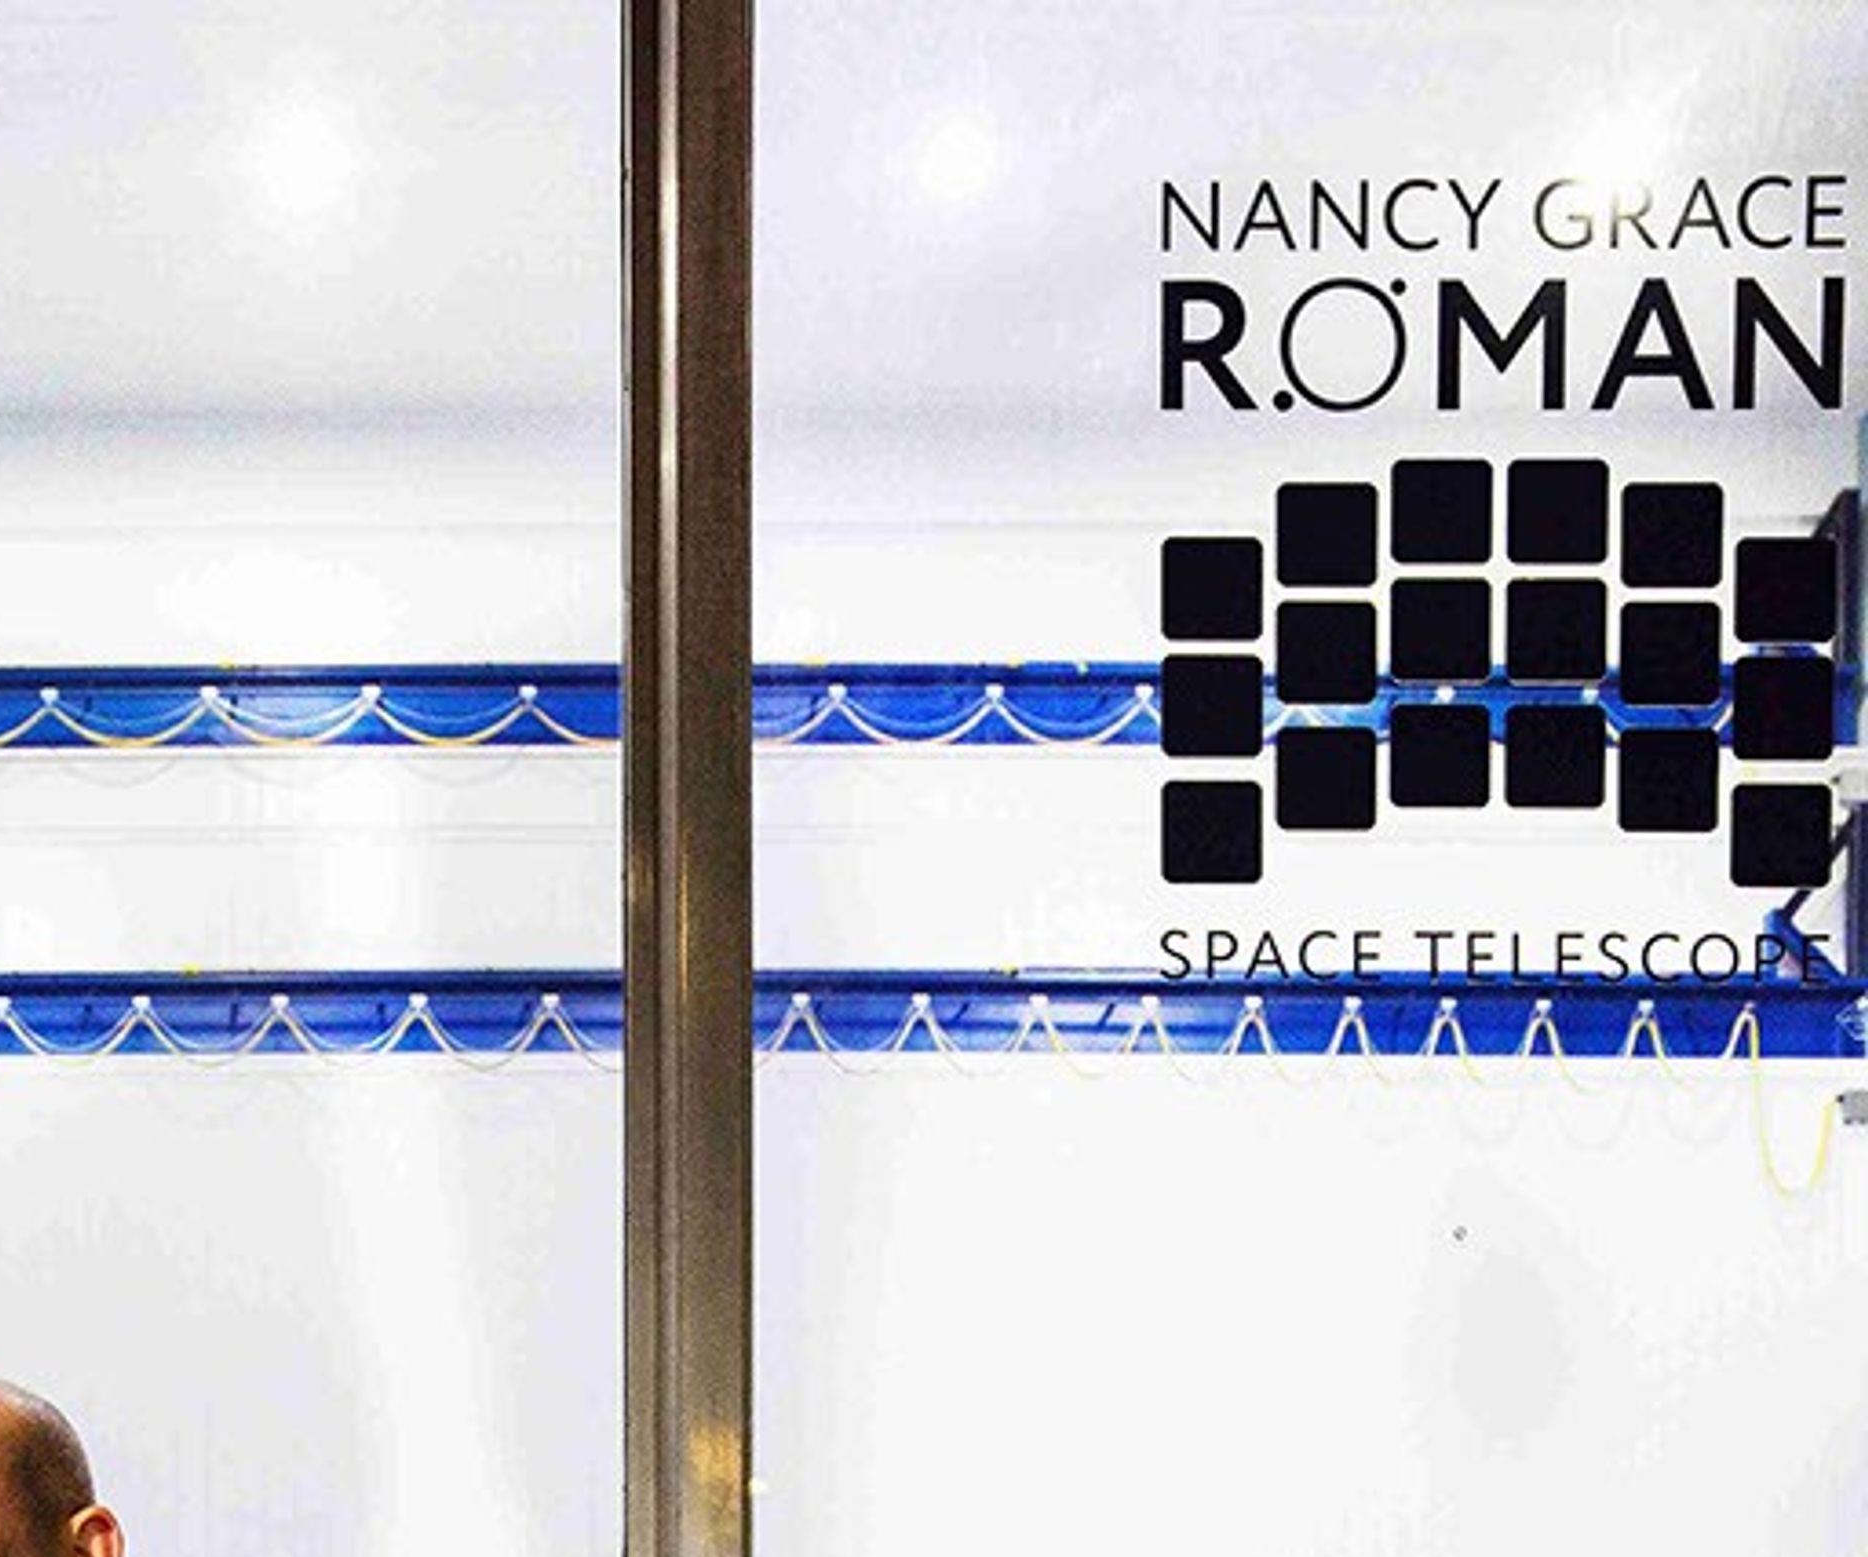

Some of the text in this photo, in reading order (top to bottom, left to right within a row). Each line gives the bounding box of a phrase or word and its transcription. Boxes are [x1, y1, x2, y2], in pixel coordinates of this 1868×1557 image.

[1161, 174, 1848, 252] NANCY GRACE
[1159, 929, 1833, 984] SPACE TELESCOPE
